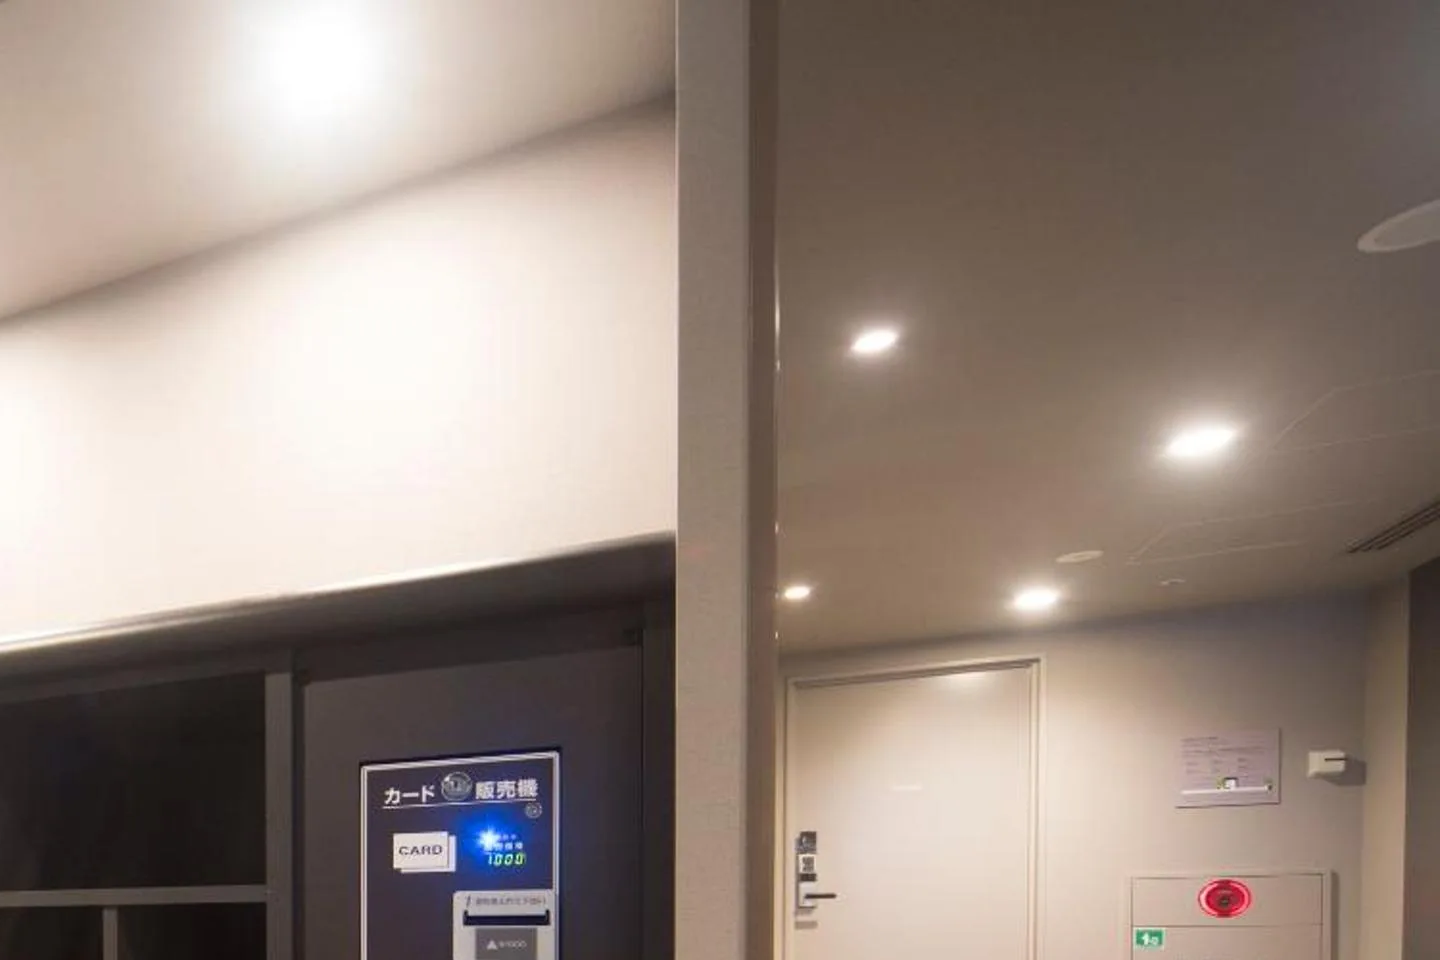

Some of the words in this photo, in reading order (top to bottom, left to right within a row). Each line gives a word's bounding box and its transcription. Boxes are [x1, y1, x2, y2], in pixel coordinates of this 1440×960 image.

[383, 784, 436, 804] カード
[475, 778, 539, 799] 販売機
[398, 844, 443, 856] CARD
